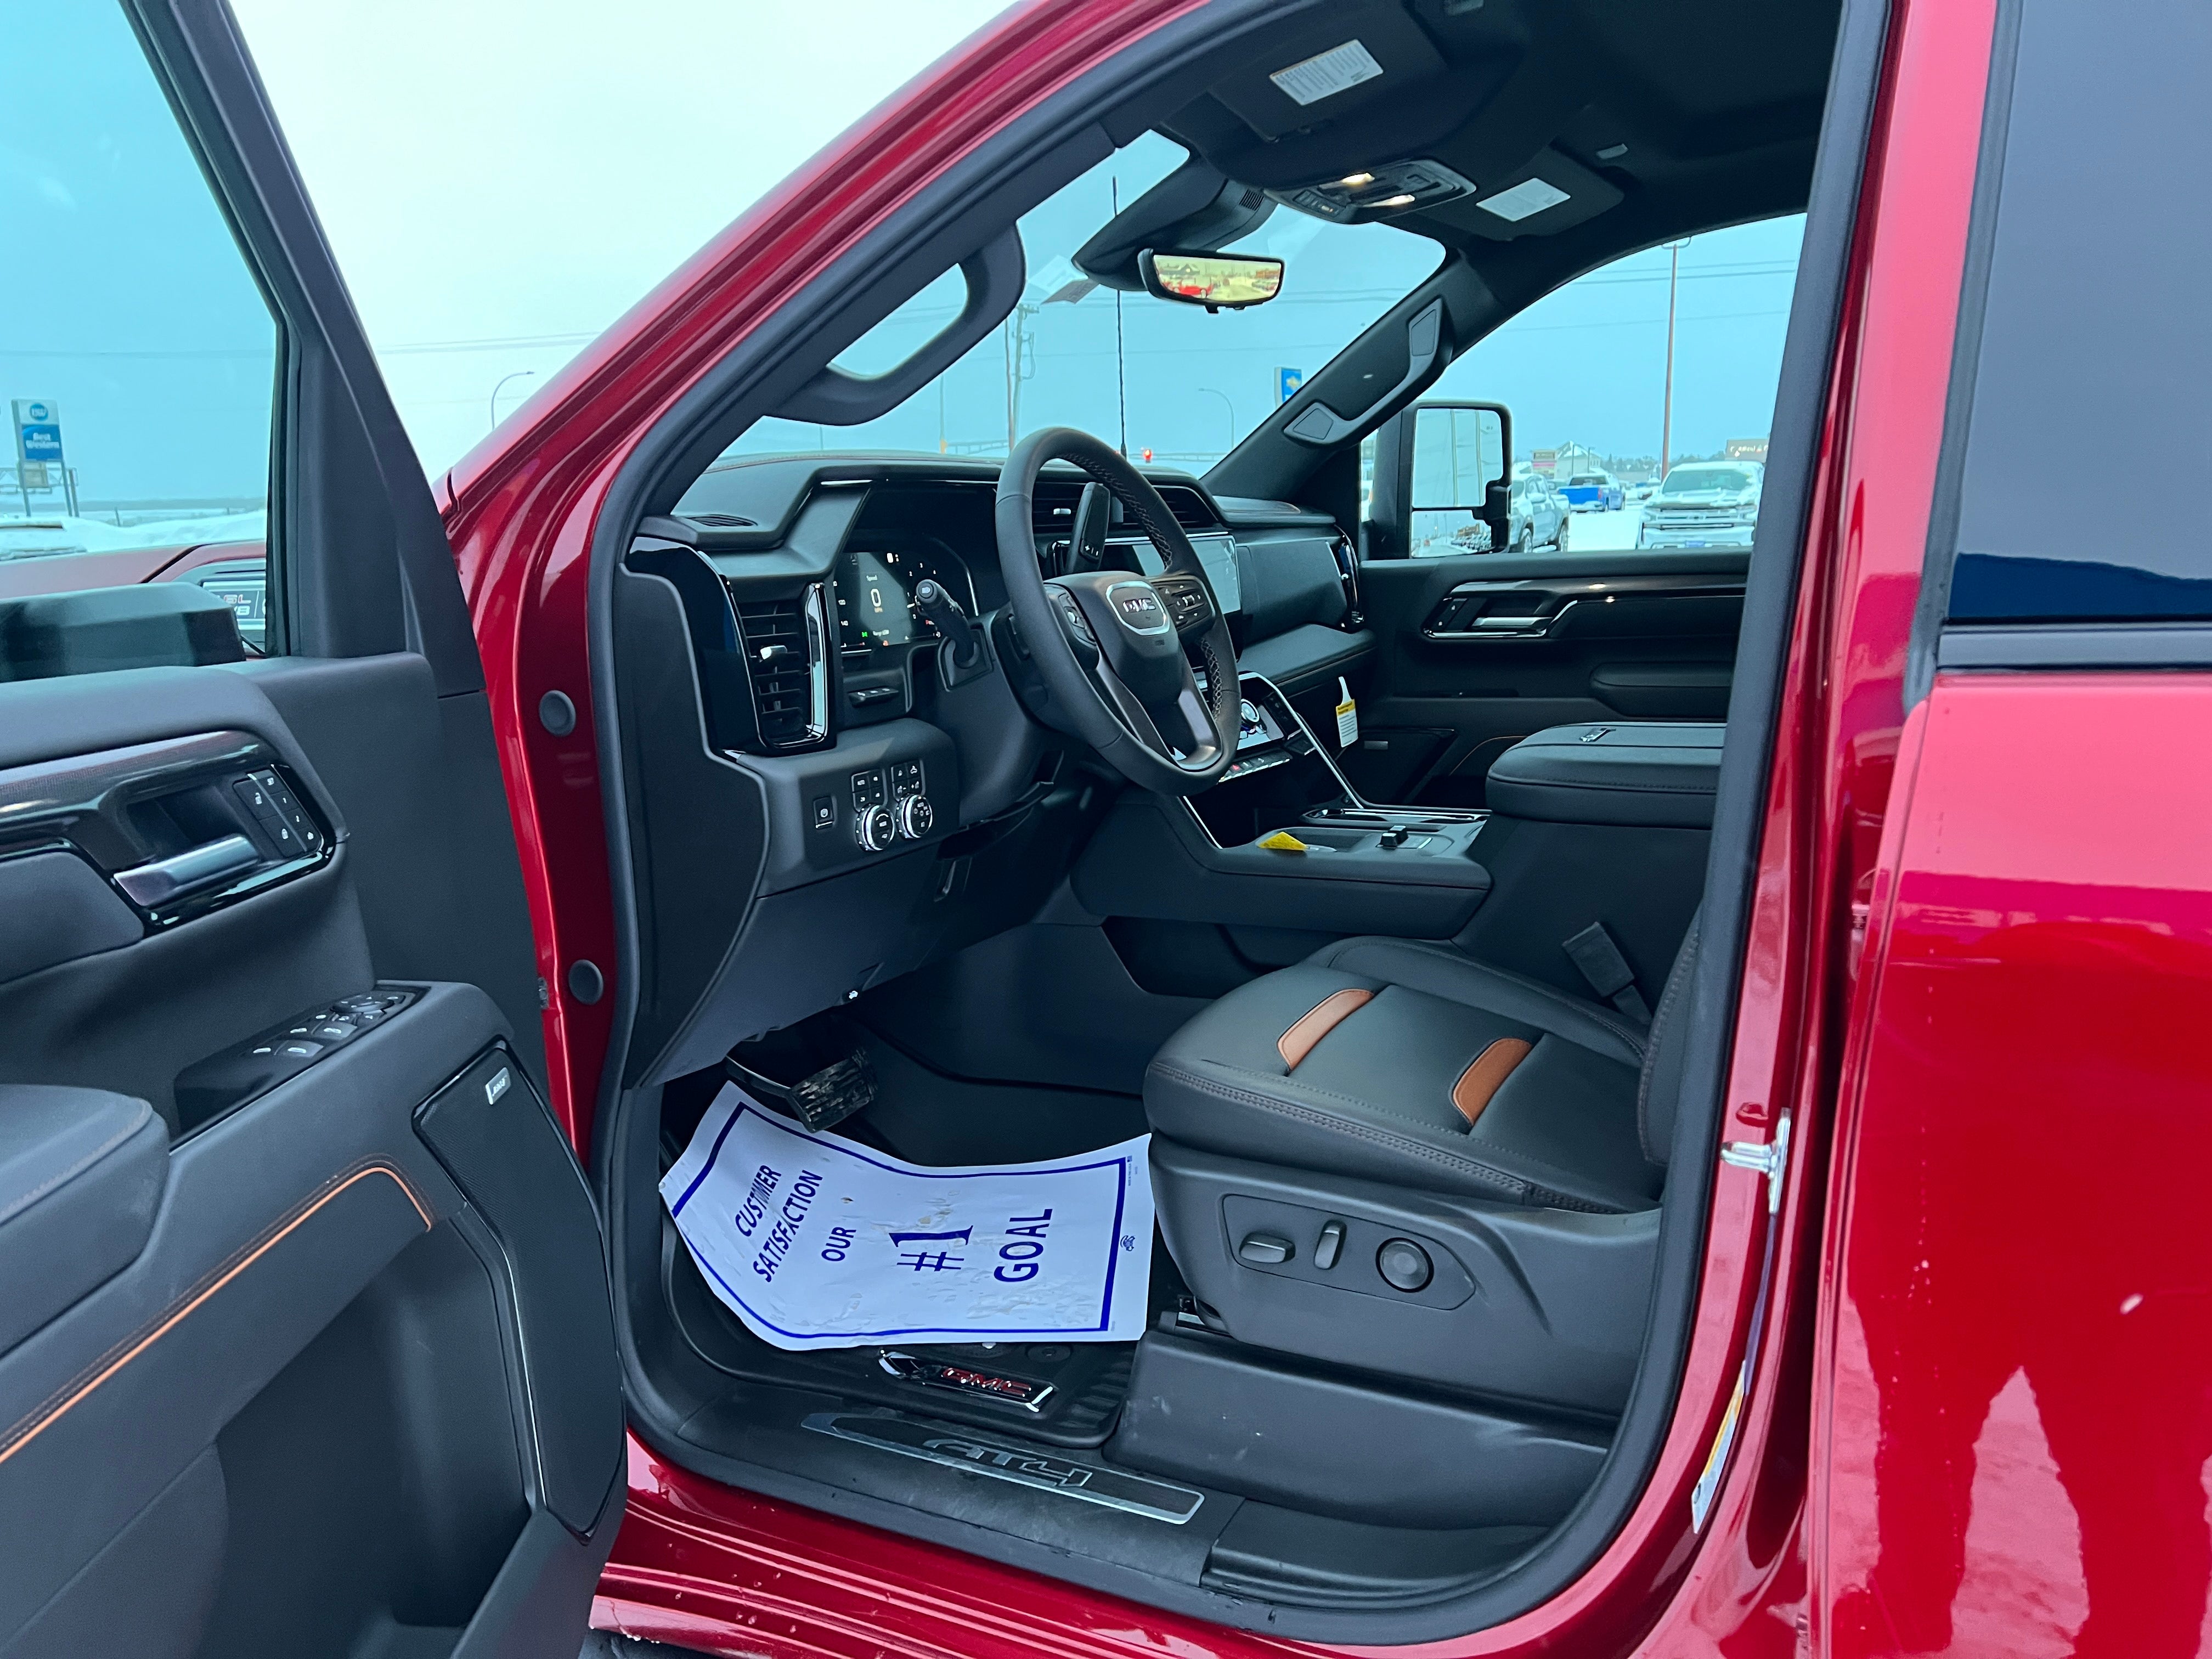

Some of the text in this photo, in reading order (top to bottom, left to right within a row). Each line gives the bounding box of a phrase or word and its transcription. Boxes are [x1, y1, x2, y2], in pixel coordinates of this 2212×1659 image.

[871, 588, 881, 607] 0
[821, 1227, 857, 1262] OUR
[888, 1224, 974, 1272] #1
[994, 1208, 1053, 1283] GOAL
[941, 1367, 1031, 1397] GMC
[922, 1438, 1093, 1487] AT4
